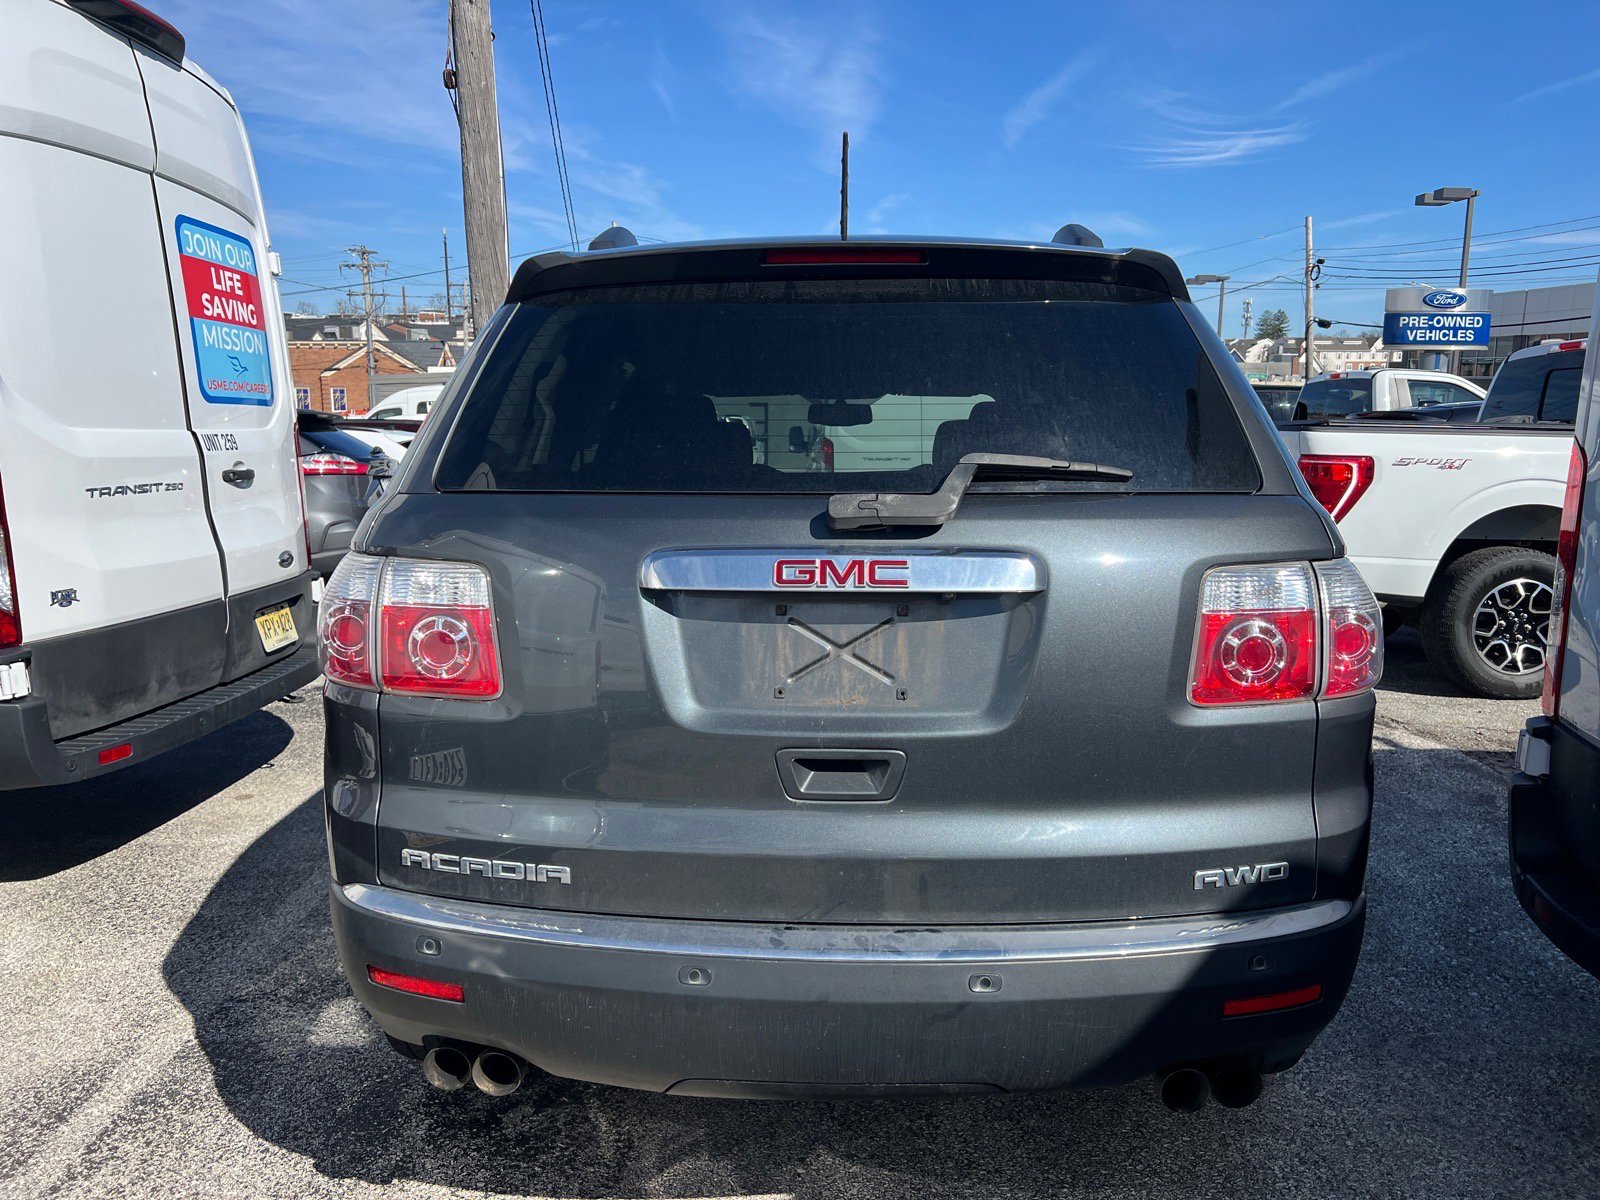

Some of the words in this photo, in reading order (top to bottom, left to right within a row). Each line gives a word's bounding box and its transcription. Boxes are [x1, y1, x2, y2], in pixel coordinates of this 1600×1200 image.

[183, 230, 222, 262] JOIN
[225, 243, 253, 272] OUR
[210, 266, 243, 296] LIFE
[201, 293, 257, 326] SAVING
[1433, 293, 1459, 305] Ford
[1399, 316, 1483, 328] PRE-OWNED
[1407, 329, 1475, 341] VEHICLES
[202, 323, 263, 355] MISSION
[201, 433, 223, 451] UNIT
[221, 433, 239, 451] 259
[1391, 457, 1472, 467] SPORT
[85, 482, 163, 499] TRANSIT
[164, 482, 184, 492] 250
[773, 558, 910, 588] GMC
[401, 848, 571, 885] ACADIA
[1193, 861, 1289, 890] AWD
